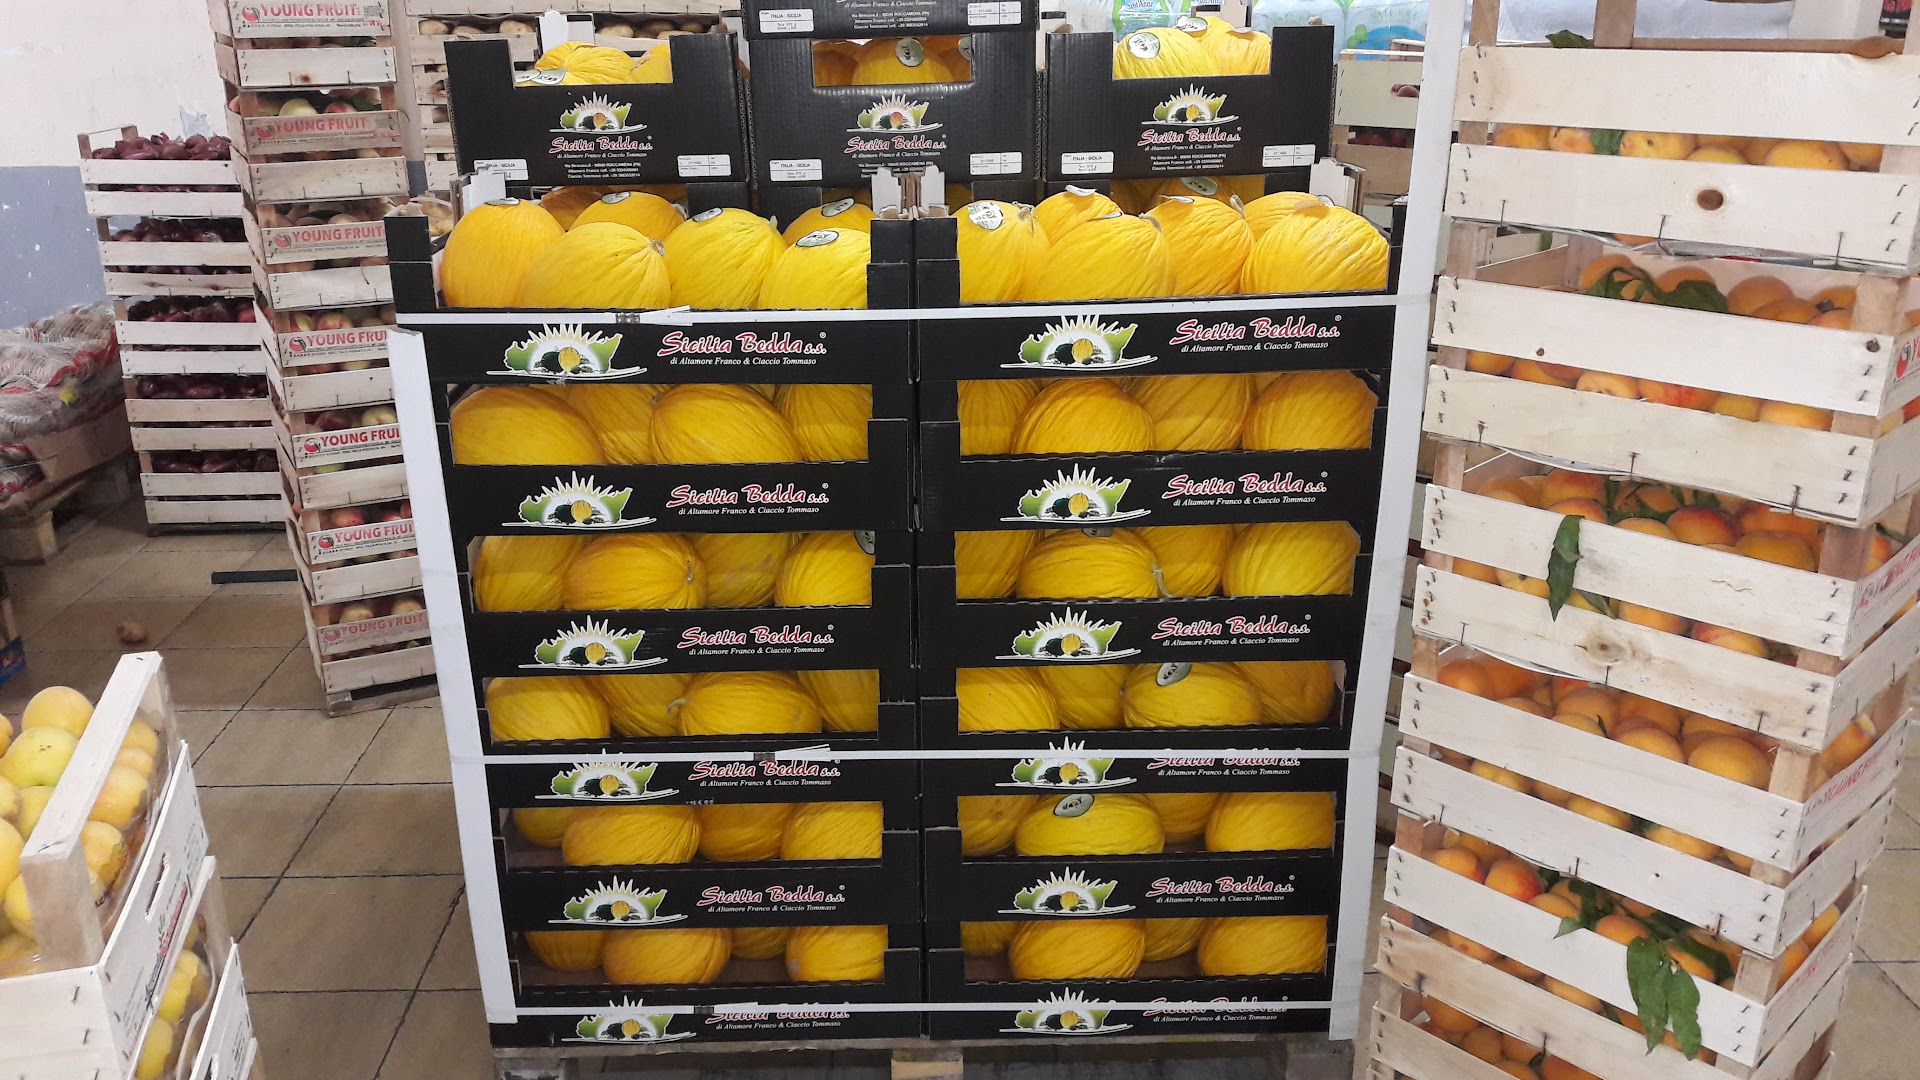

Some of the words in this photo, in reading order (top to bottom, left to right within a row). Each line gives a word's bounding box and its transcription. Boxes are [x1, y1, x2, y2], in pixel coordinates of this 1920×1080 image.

[261, 3, 313, 17] YOUNG
[317, 3, 357, 16] FRUIT
[275, 118, 325, 132] YOUNG
[326, 117, 367, 131] FRUIT
[548, 136, 595, 154] Sicilia
[596, 135, 638, 151] Bedda
[844, 136, 890, 154] Sicilia
[891, 135, 933, 150] Bedda
[1137, 129, 1183, 146] Sicilia
[1185, 127, 1226, 142] Bedda
[292, 228, 342, 242] YOUNG
[345, 225, 384, 240] FRUIT
[306, 332, 355, 347] YOUNG
[358, 331, 387, 342] FRUI
[1169, 319, 1246, 345] Sicilia
[1249, 316, 1317, 338] Bedda
[657, 331, 732, 356] Sicilia
[735, 332, 803, 354] Bedda
[1190, 344, 1224, 352] Altamore
[1254, 343, 1261, 351] &
[1294, 342, 1328, 350] Tommaso
[670, 357, 678, 365] di
[679, 357, 713, 365] Altamore
[714, 357, 741, 365] Franco
[743, 357, 751, 365] &
[752, 357, 781, 365] Ciaccio
[782, 357, 816, 365] Tommaso
[320, 432, 368, 447] YOUNG
[371, 428, 400, 440] FRUI
[1162, 474, 1235, 499] Sicilia
[1238, 472, 1303, 493] Bedda
[666, 484, 738, 508] Sicilia
[741, 483, 806, 503] Bedda
[1173, 498, 1181, 506] di
[1216, 497, 1242, 505] Franco
[1244, 497, 1250, 505] &
[1282, 496, 1316, 504] Tommaso
[335, 527, 381, 542] YOUNG
[384, 524, 413, 536] FRUI
[677, 627, 747, 648] Sicilia
[750, 625, 812, 644] Bedda
[1151, 617, 1222, 640] Sicilia
[1225, 615, 1288, 634] Bedda
[688, 760, 756, 780] Sicilia
[697, 886, 763, 906] Sicilia
[765, 885, 824, 902] Bedda
[1145, 877, 1212, 897] Sicilia
[1215, 876, 1273, 893] Bedda
